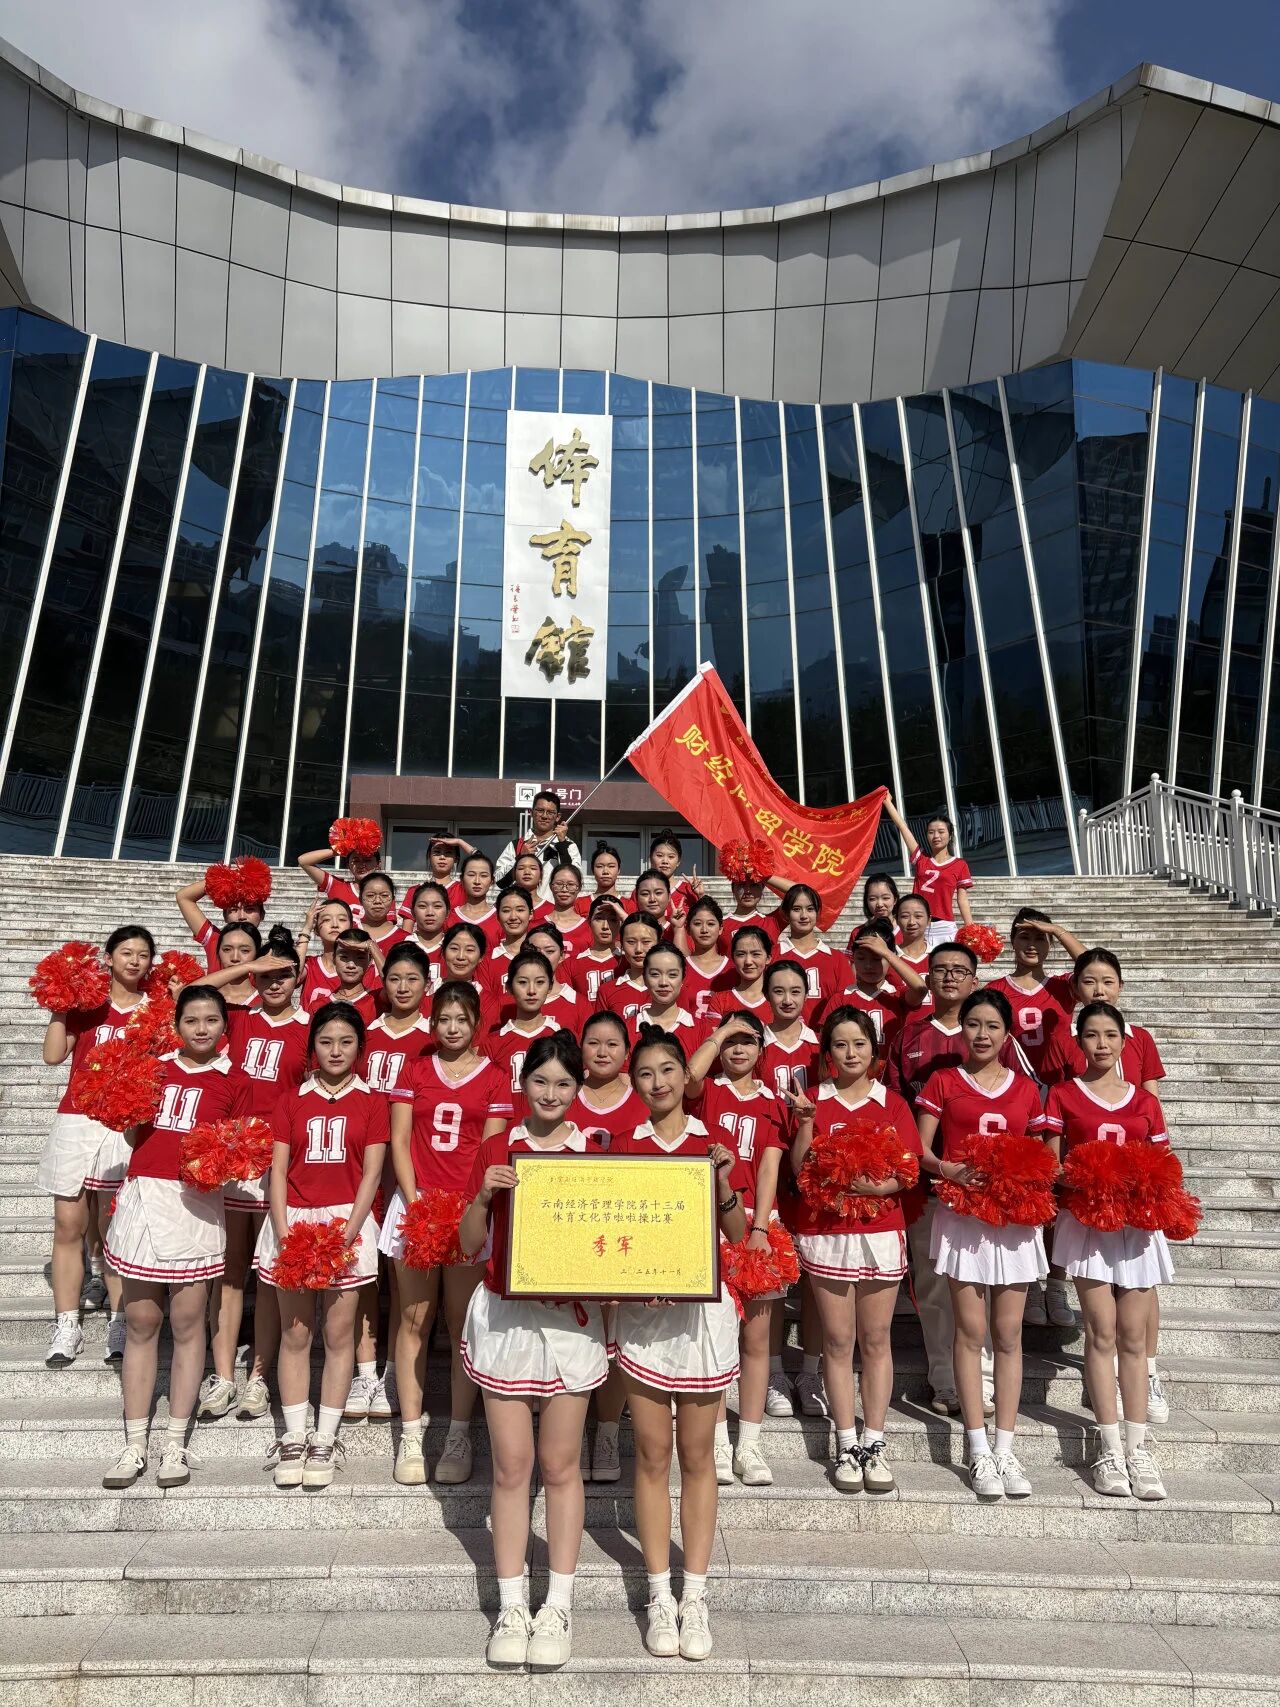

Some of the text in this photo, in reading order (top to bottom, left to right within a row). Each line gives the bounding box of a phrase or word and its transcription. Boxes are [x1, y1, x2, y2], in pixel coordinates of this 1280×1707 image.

[921, 870, 940, 893] 2
[1018, 1007, 1044, 1046] 9
[241, 1038, 284, 1082] 11
[367, 1051, 406, 1092] 11
[154, 1084, 203, 1133] 11
[431, 1102, 463, 1151] 9
[305, 1116, 347, 1163] 11
[541, 1198, 685, 1211] 云南经济管理学院第十三届
[552, 1212, 673, 1224] 体育文化节啦啦操比赛
[592, 1234, 634, 1257] 季军
